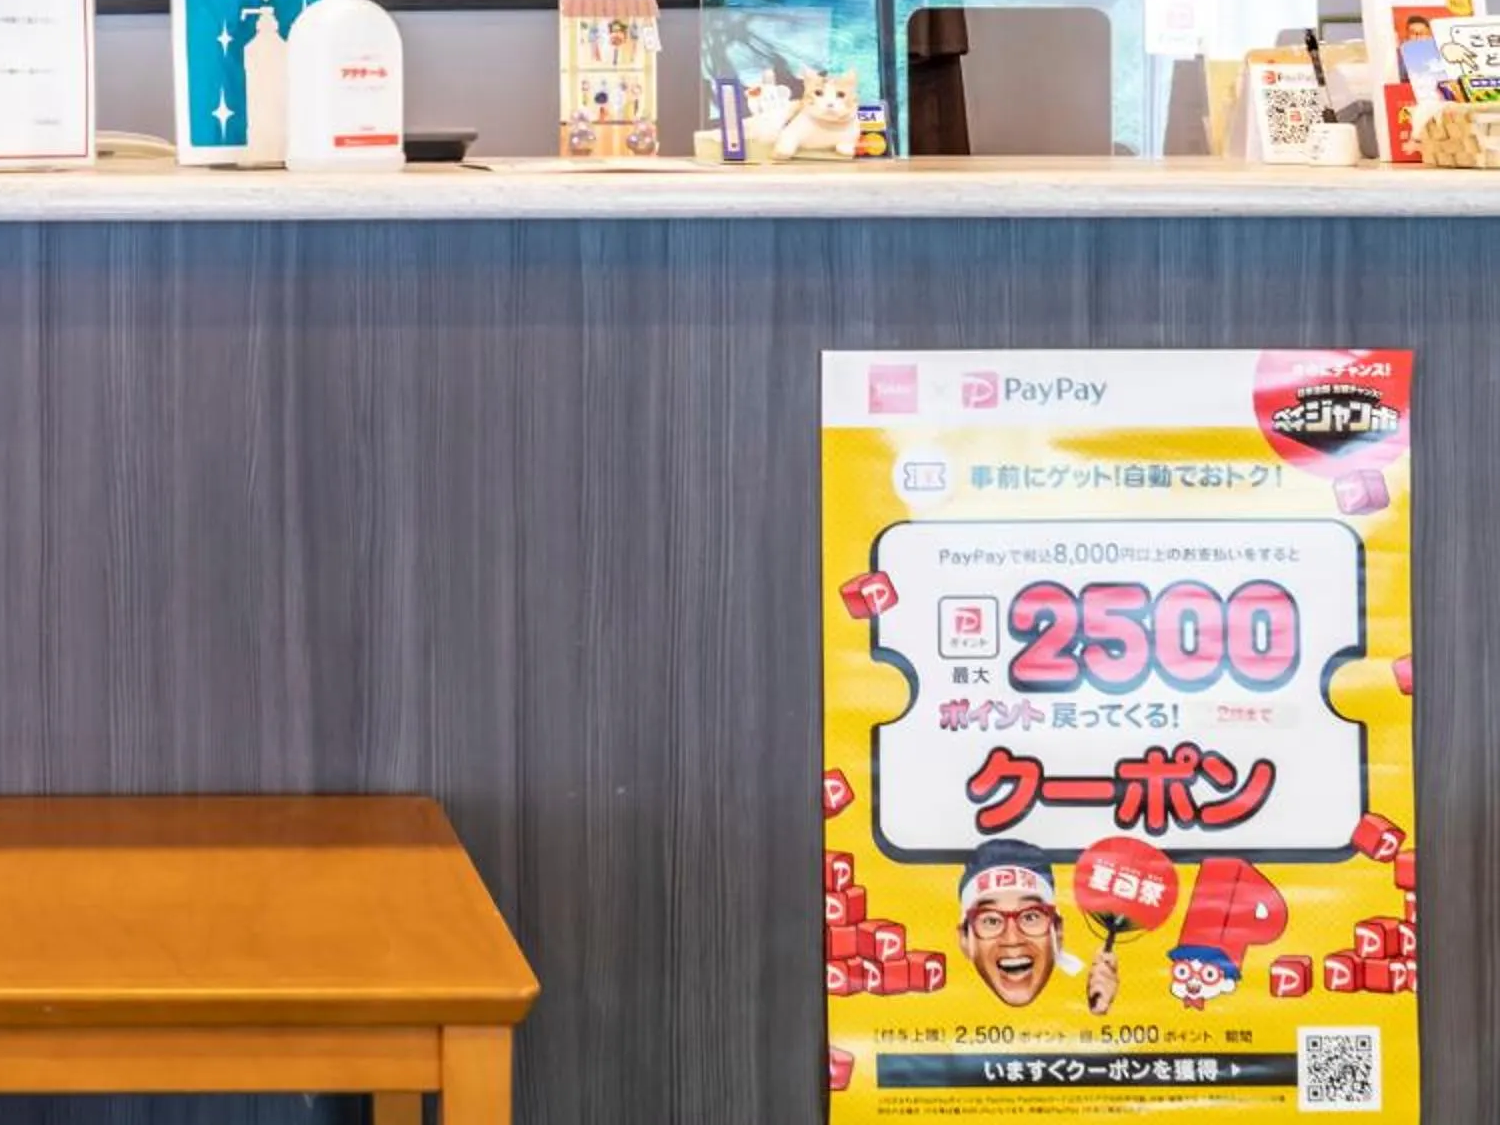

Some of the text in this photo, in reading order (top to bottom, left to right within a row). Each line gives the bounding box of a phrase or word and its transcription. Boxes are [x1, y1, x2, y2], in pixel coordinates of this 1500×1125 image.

[1004, 377, 1107, 405] PayPay
[1008, 579, 1301, 695] 2500
[952, 666, 991, 685] 最大
[966, 741, 1277, 837] クーポン
[984, 1058, 1218, 1081] いますぐクーポンを獲得
